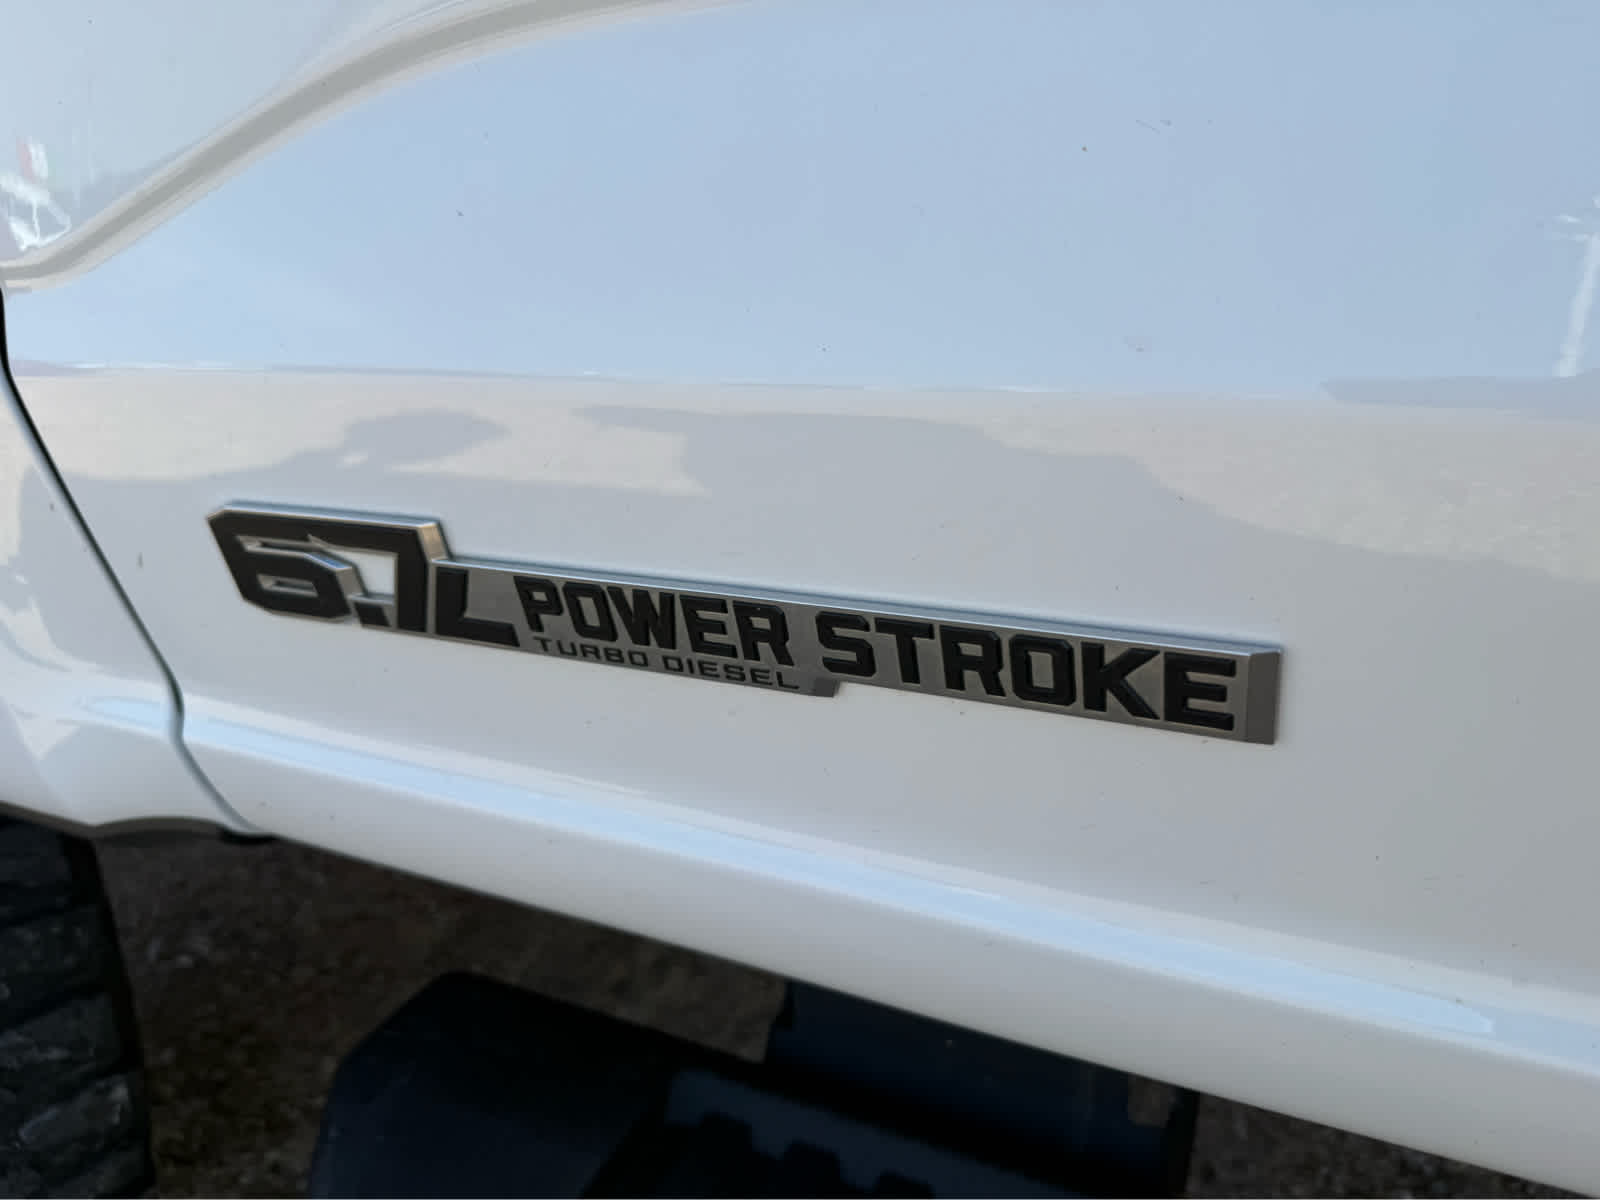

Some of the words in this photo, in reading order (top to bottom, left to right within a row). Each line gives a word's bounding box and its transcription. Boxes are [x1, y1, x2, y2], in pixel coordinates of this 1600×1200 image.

[208, 508, 520, 648] 6.7L
[513, 575, 795, 667] POWER
[815, 610, 1237, 732] STROKE
[532, 636, 649, 668] TURBO
[662, 655, 800, 690] DIESEL
